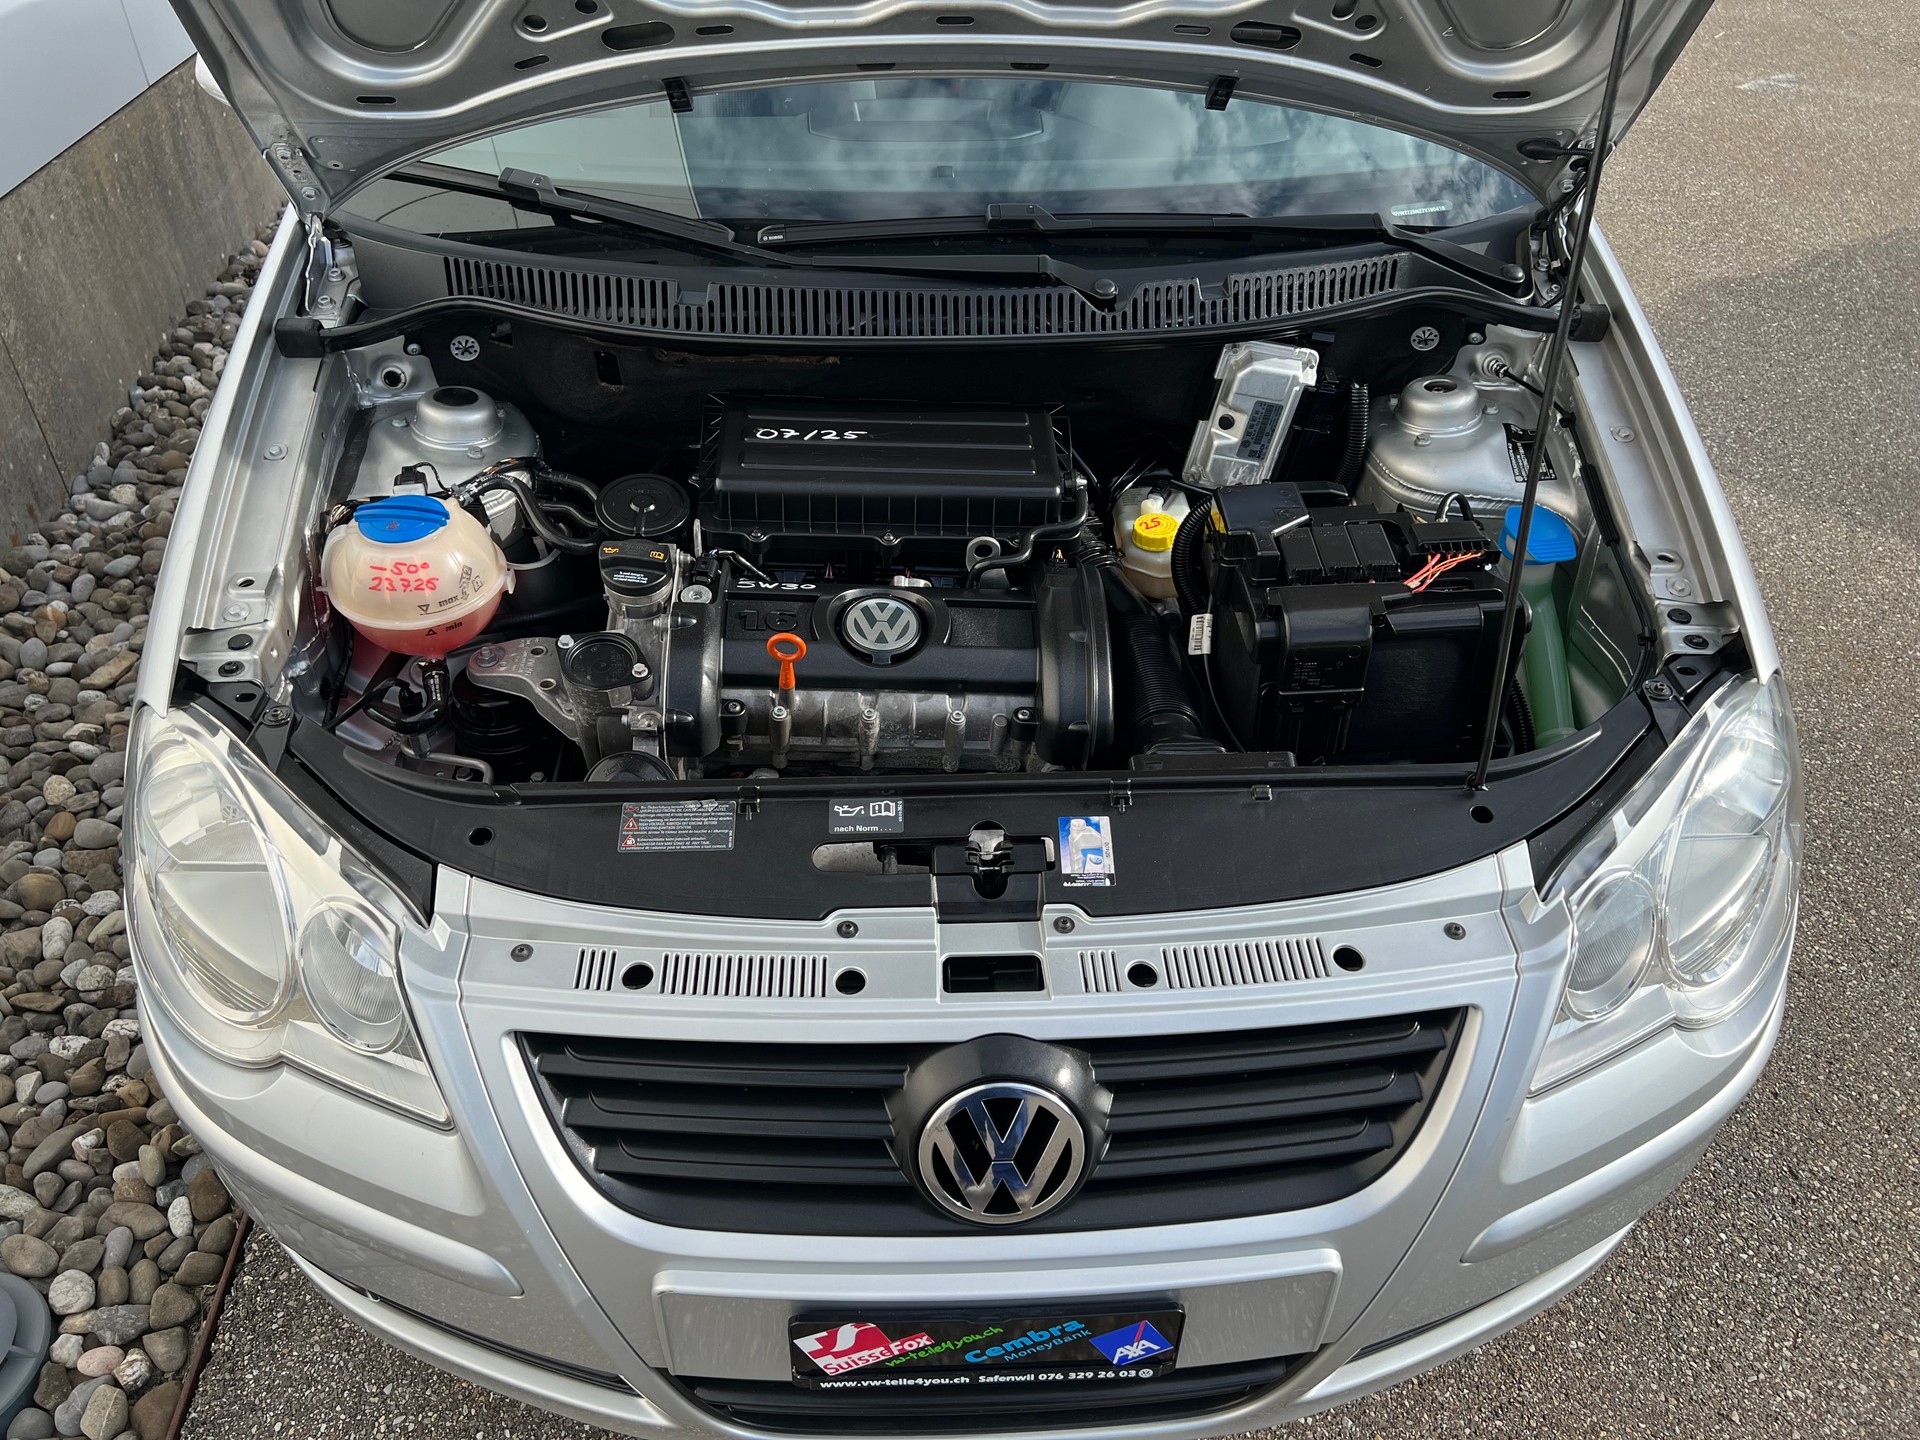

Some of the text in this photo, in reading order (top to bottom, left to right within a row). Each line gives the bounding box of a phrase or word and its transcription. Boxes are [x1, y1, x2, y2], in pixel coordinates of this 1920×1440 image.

[756, 428, 868, 440] 07/25
[439, 595, 459, 607] max
[885, 1327, 1004, 1367] vw-teile4you.ch
[965, 1320, 1085, 1363] Cembra
[1004, 1329, 1092, 1362] MoneyBank
[1113, 1340, 1161, 1365] AXA
[820, 1376, 970, 1388] www.vw-teile4you.ch
[979, 1374, 1035, 1383] Safenwil
[1038, 1373, 1064, 1381] 076
[1067, 1372, 1094, 1380] 329
